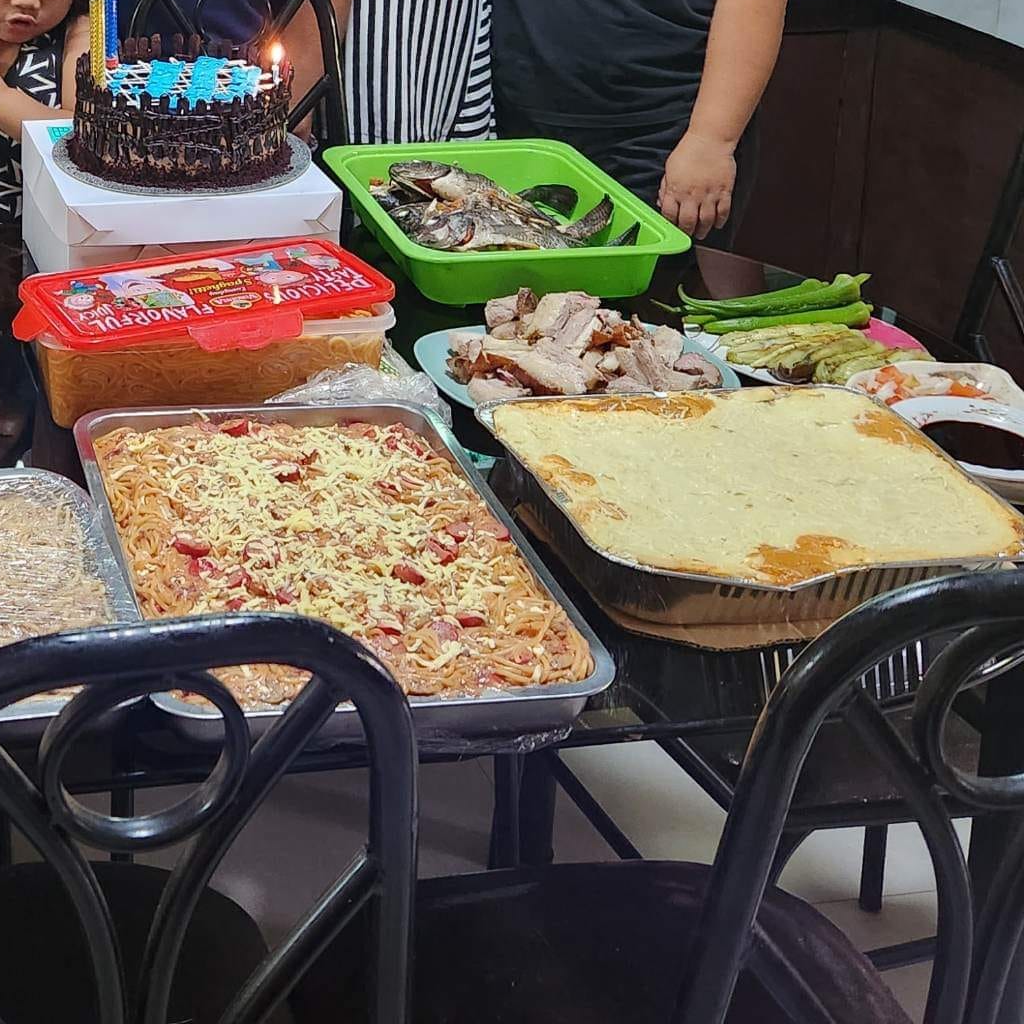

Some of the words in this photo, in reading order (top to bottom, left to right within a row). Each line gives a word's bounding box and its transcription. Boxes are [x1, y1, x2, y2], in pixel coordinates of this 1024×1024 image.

[310, 266, 364, 283] TASTY
[78, 303, 115, 322] JUICY
[87, 303, 215, 332] FLAVORFUL
